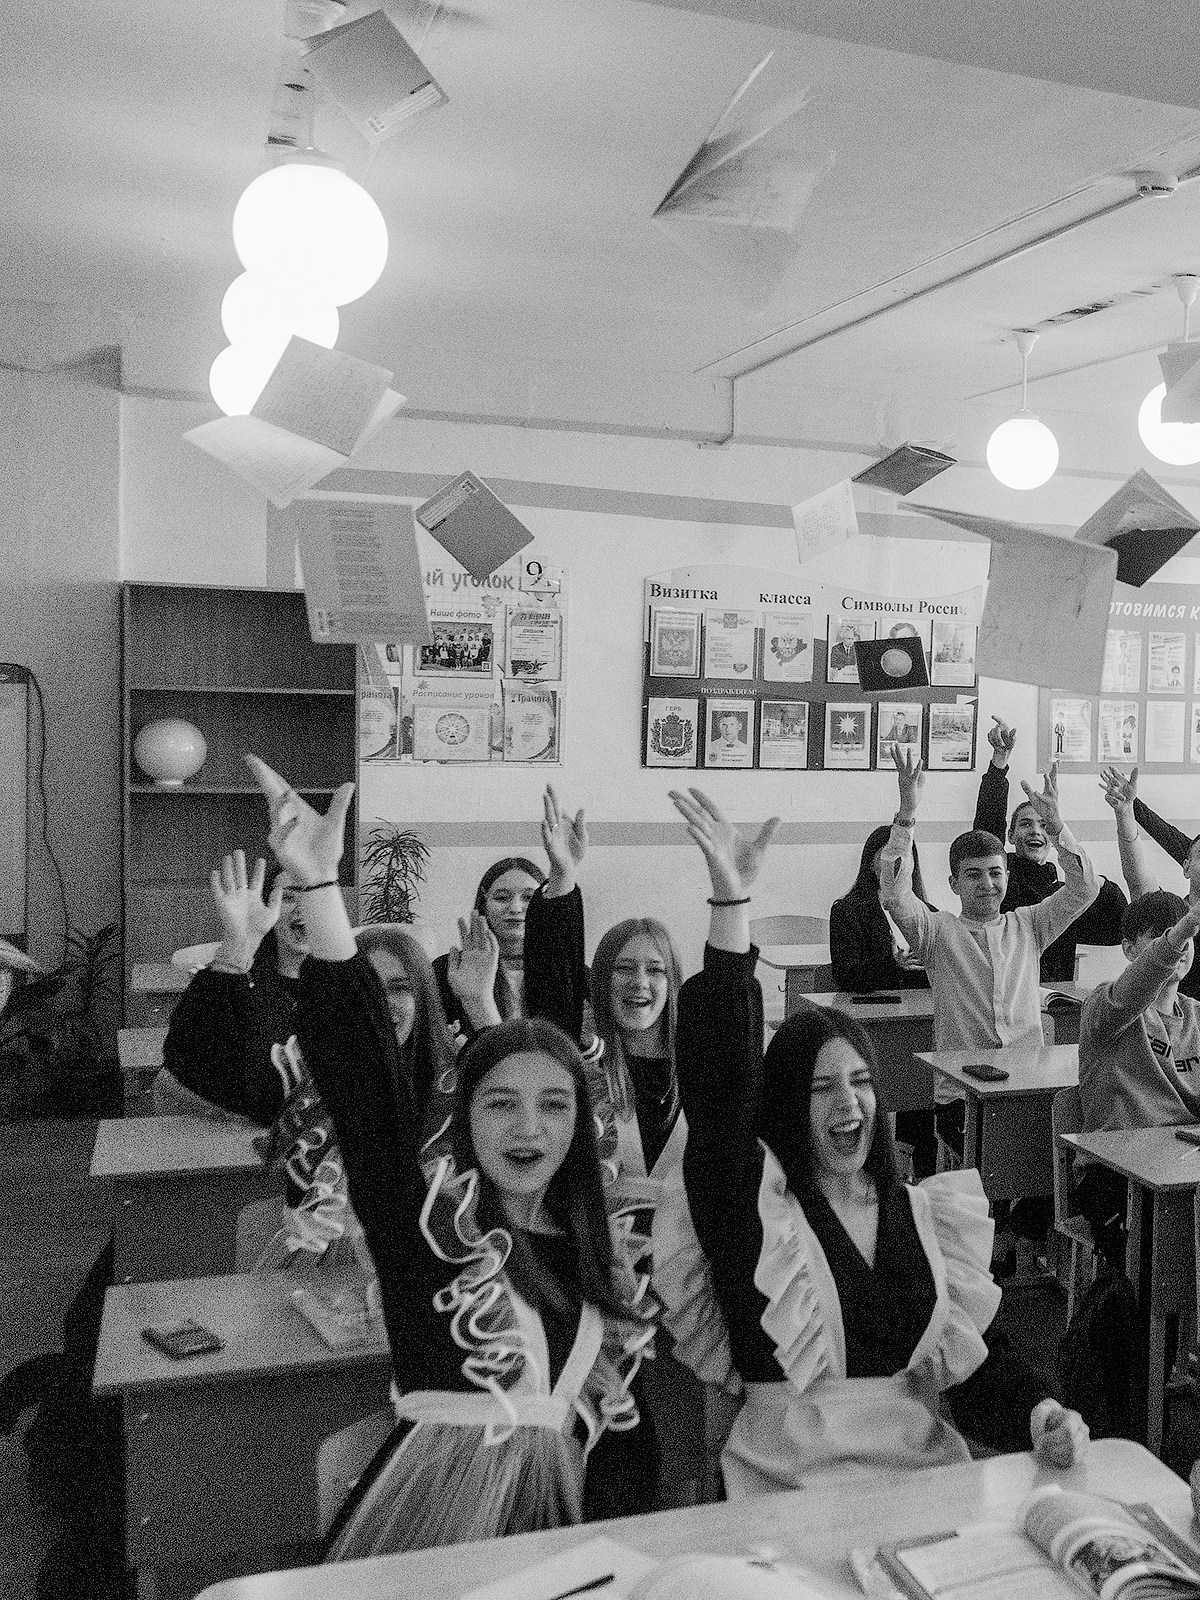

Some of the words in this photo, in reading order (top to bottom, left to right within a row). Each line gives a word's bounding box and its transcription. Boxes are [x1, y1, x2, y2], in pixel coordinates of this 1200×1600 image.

[650, 583, 719, 600] Визитка
[759, 593, 812, 605] класса
[841, 596, 913, 613] Символы
[430, 608, 455, 618] Наше
[456, 609, 482, 619] фото
[1190, 605, 1200, 620] К
[412, 689, 463, 700] Расписание
[464, 690, 495, 700] уроков
[517, 693, 551, 704] Грамота
